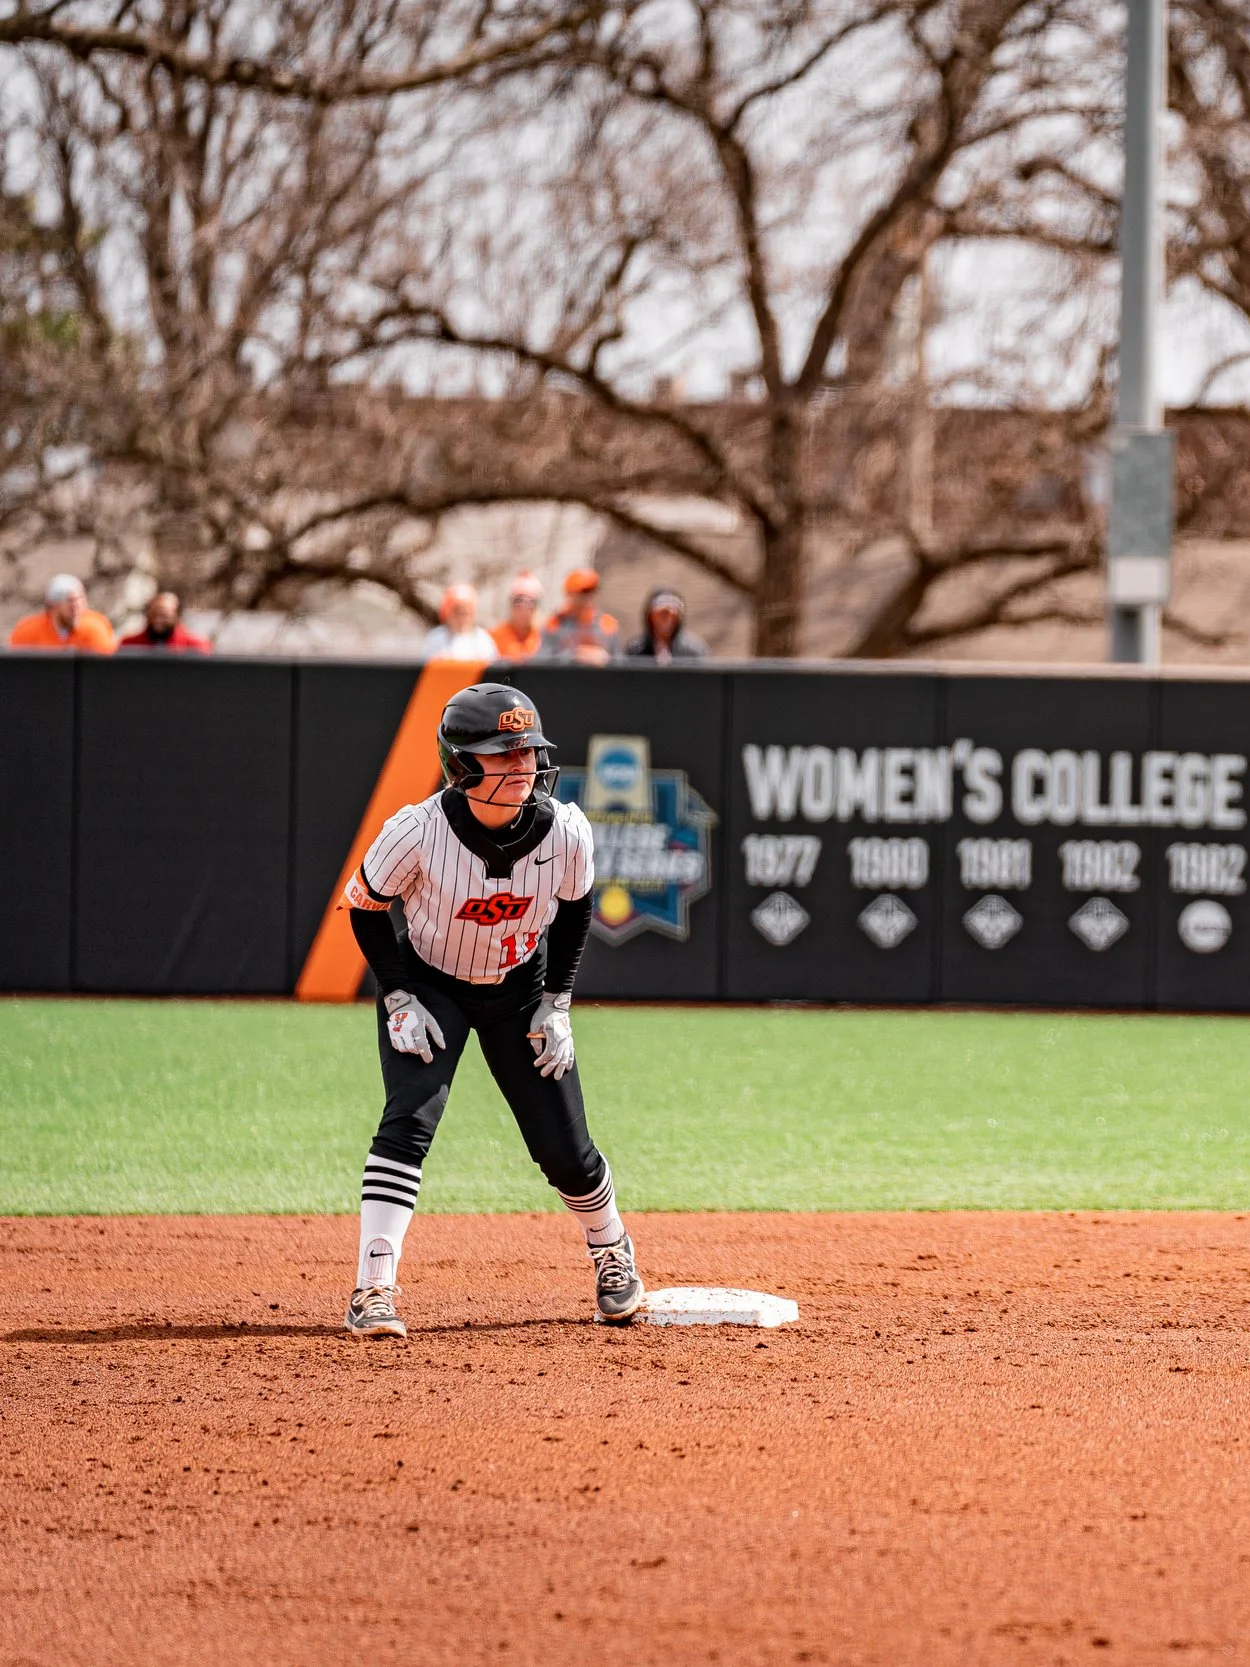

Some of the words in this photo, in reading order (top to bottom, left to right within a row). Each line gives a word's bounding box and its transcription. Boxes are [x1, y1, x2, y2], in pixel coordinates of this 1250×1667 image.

[498, 706, 535, 732] OSU
[743, 739, 1003, 823] WOMEN'S
[1011, 748, 1247, 828] COLLEGE
[743, 835, 821, 886] 1977
[455, 892, 534, 926] OSU
